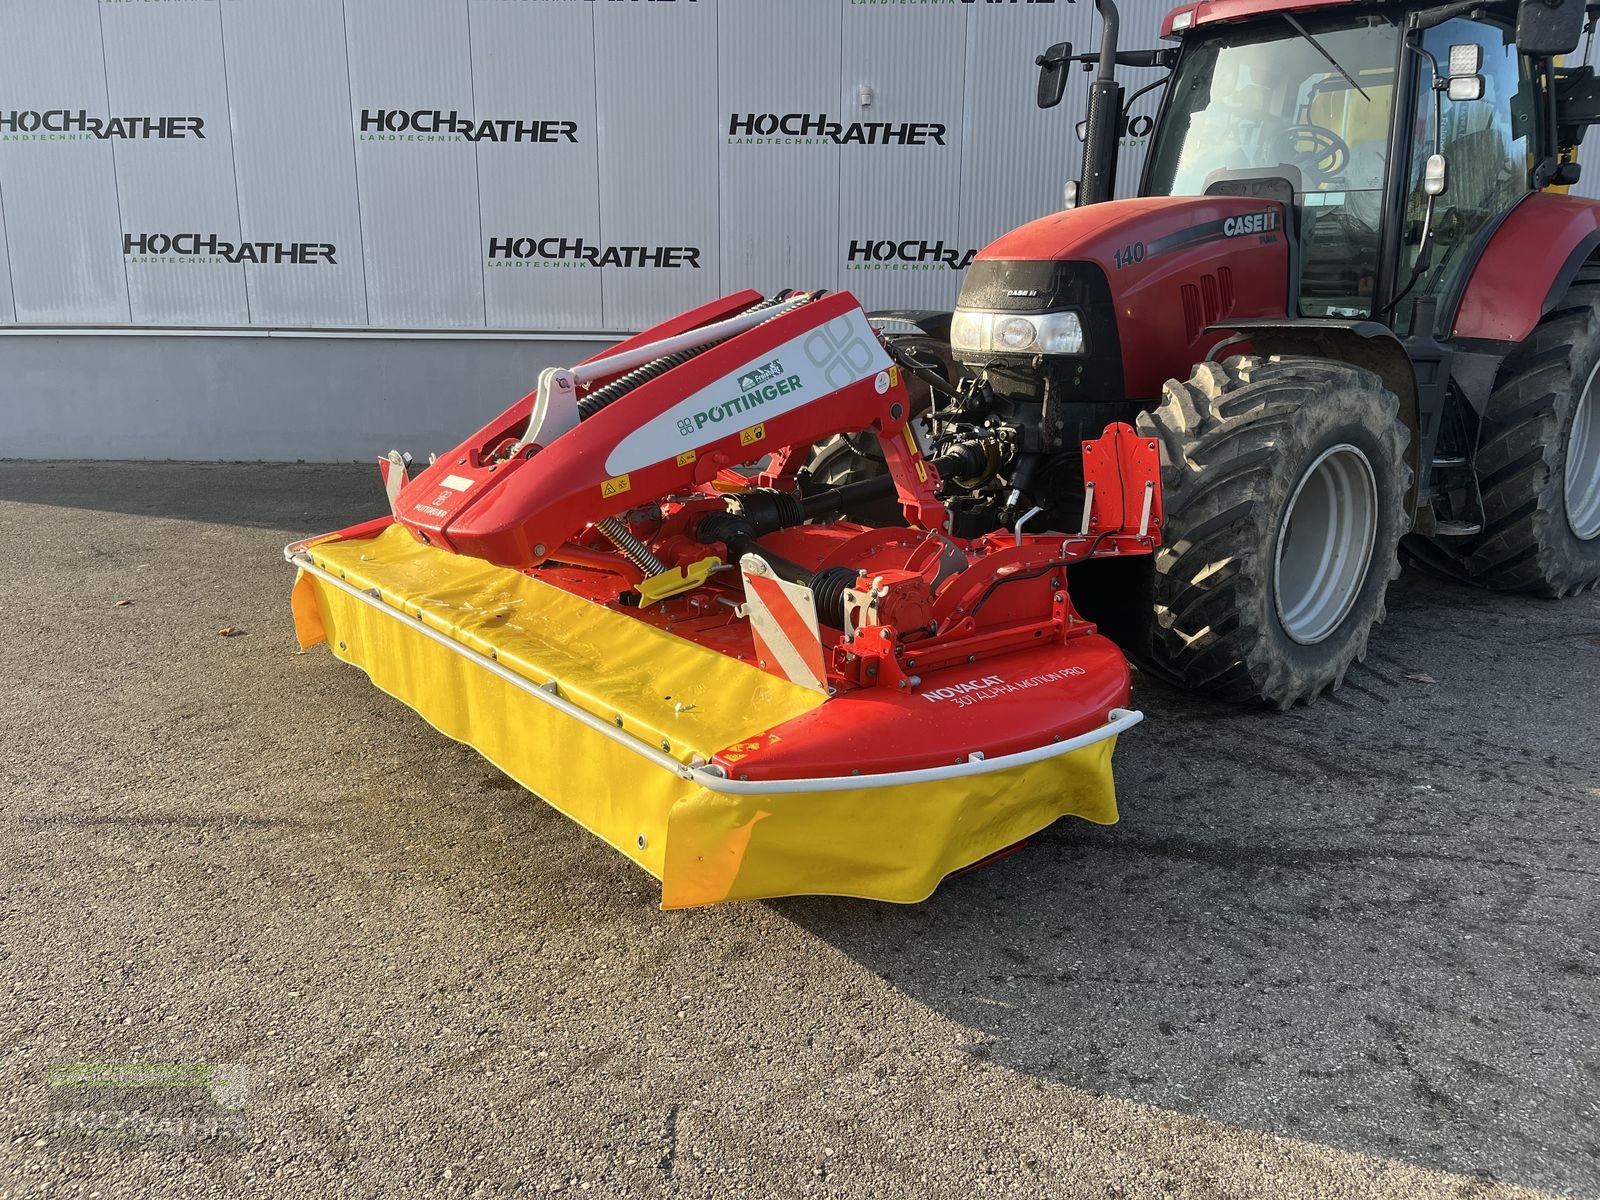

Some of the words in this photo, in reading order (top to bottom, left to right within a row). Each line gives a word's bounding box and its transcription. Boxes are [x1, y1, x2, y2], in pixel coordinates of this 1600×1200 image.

[0, 110, 206, 139] HOCHRATHER
[0, 133, 93, 141] ANDTECHNIK
[360, 109, 579, 143] HOCHRATHER
[360, 134, 465, 142] LANDTECHNIK
[729, 113, 946, 146] HOCHRATHER
[728, 137, 830, 145] LANDTECHNIK
[1224, 214, 1262, 237] CASE
[123, 233, 338, 265] HOCHRATHER
[488, 237, 701, 268] HOCHRATHER
[848, 240, 978, 270] HOCHRA
[1113, 241, 1145, 271] 140
[846, 263, 945, 271] LANDTECHNIK
[693, 374, 803, 430] PÖTTINGER
[920, 675, 1005, 703] NOVACAT
[950, 692, 978, 708] 301
[977, 684, 1021, 701] ALPHA
[1015, 672, 1062, 690] MOTION
[1058, 666, 1087, 678] PRO
